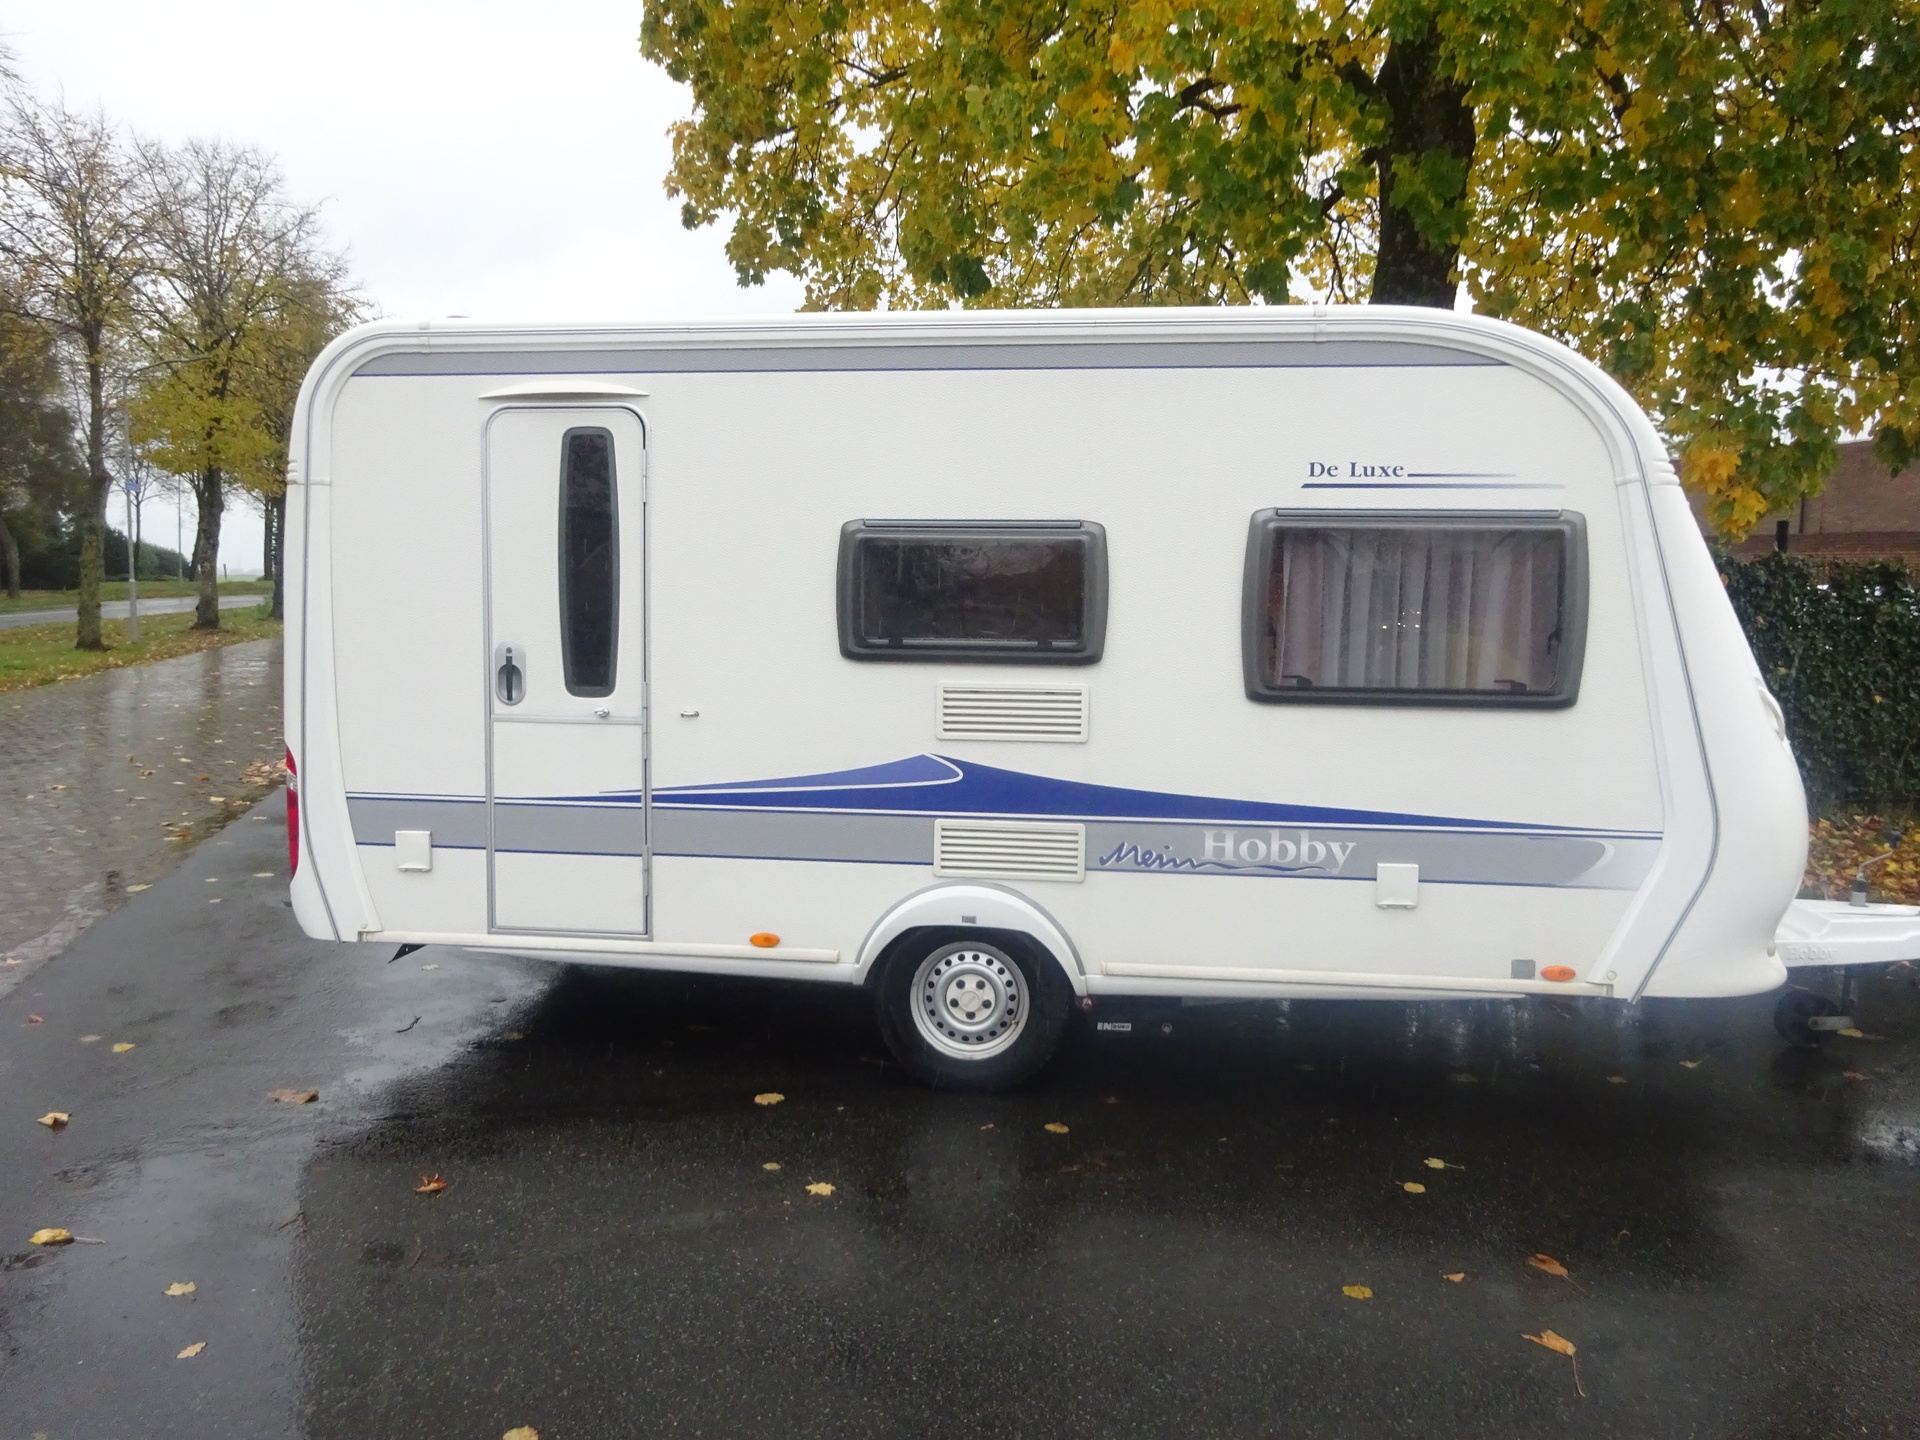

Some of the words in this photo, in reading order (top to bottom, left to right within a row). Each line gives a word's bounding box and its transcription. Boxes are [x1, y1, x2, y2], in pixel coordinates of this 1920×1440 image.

[1309, 461, 1339, 478] De
[1349, 461, 1405, 478] Luxe
[1099, 841, 1203, 871] Mein
[1201, 828, 1358, 875] Hobby
[1785, 944, 1838, 963] Hobby
